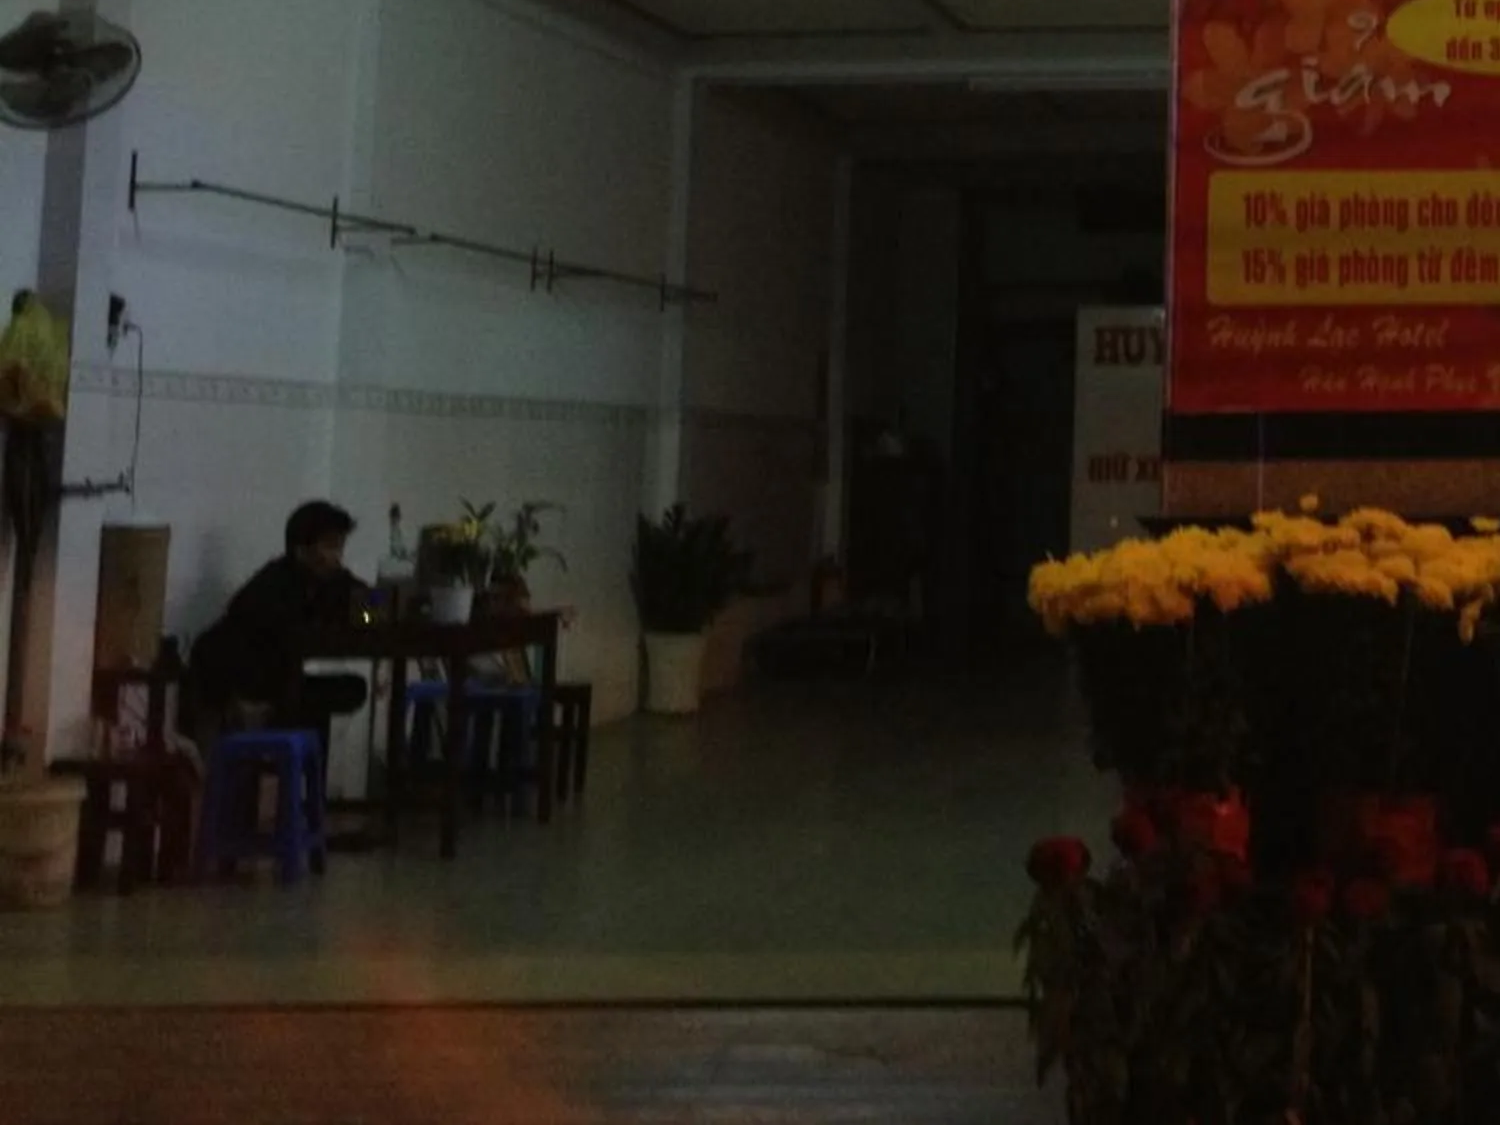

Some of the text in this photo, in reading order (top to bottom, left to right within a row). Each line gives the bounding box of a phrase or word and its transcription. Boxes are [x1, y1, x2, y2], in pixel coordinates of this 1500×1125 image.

[1242, 191, 1289, 229] 10%
[1416, 192, 1460, 228] cho
[1242, 248, 1287, 285] 15%
